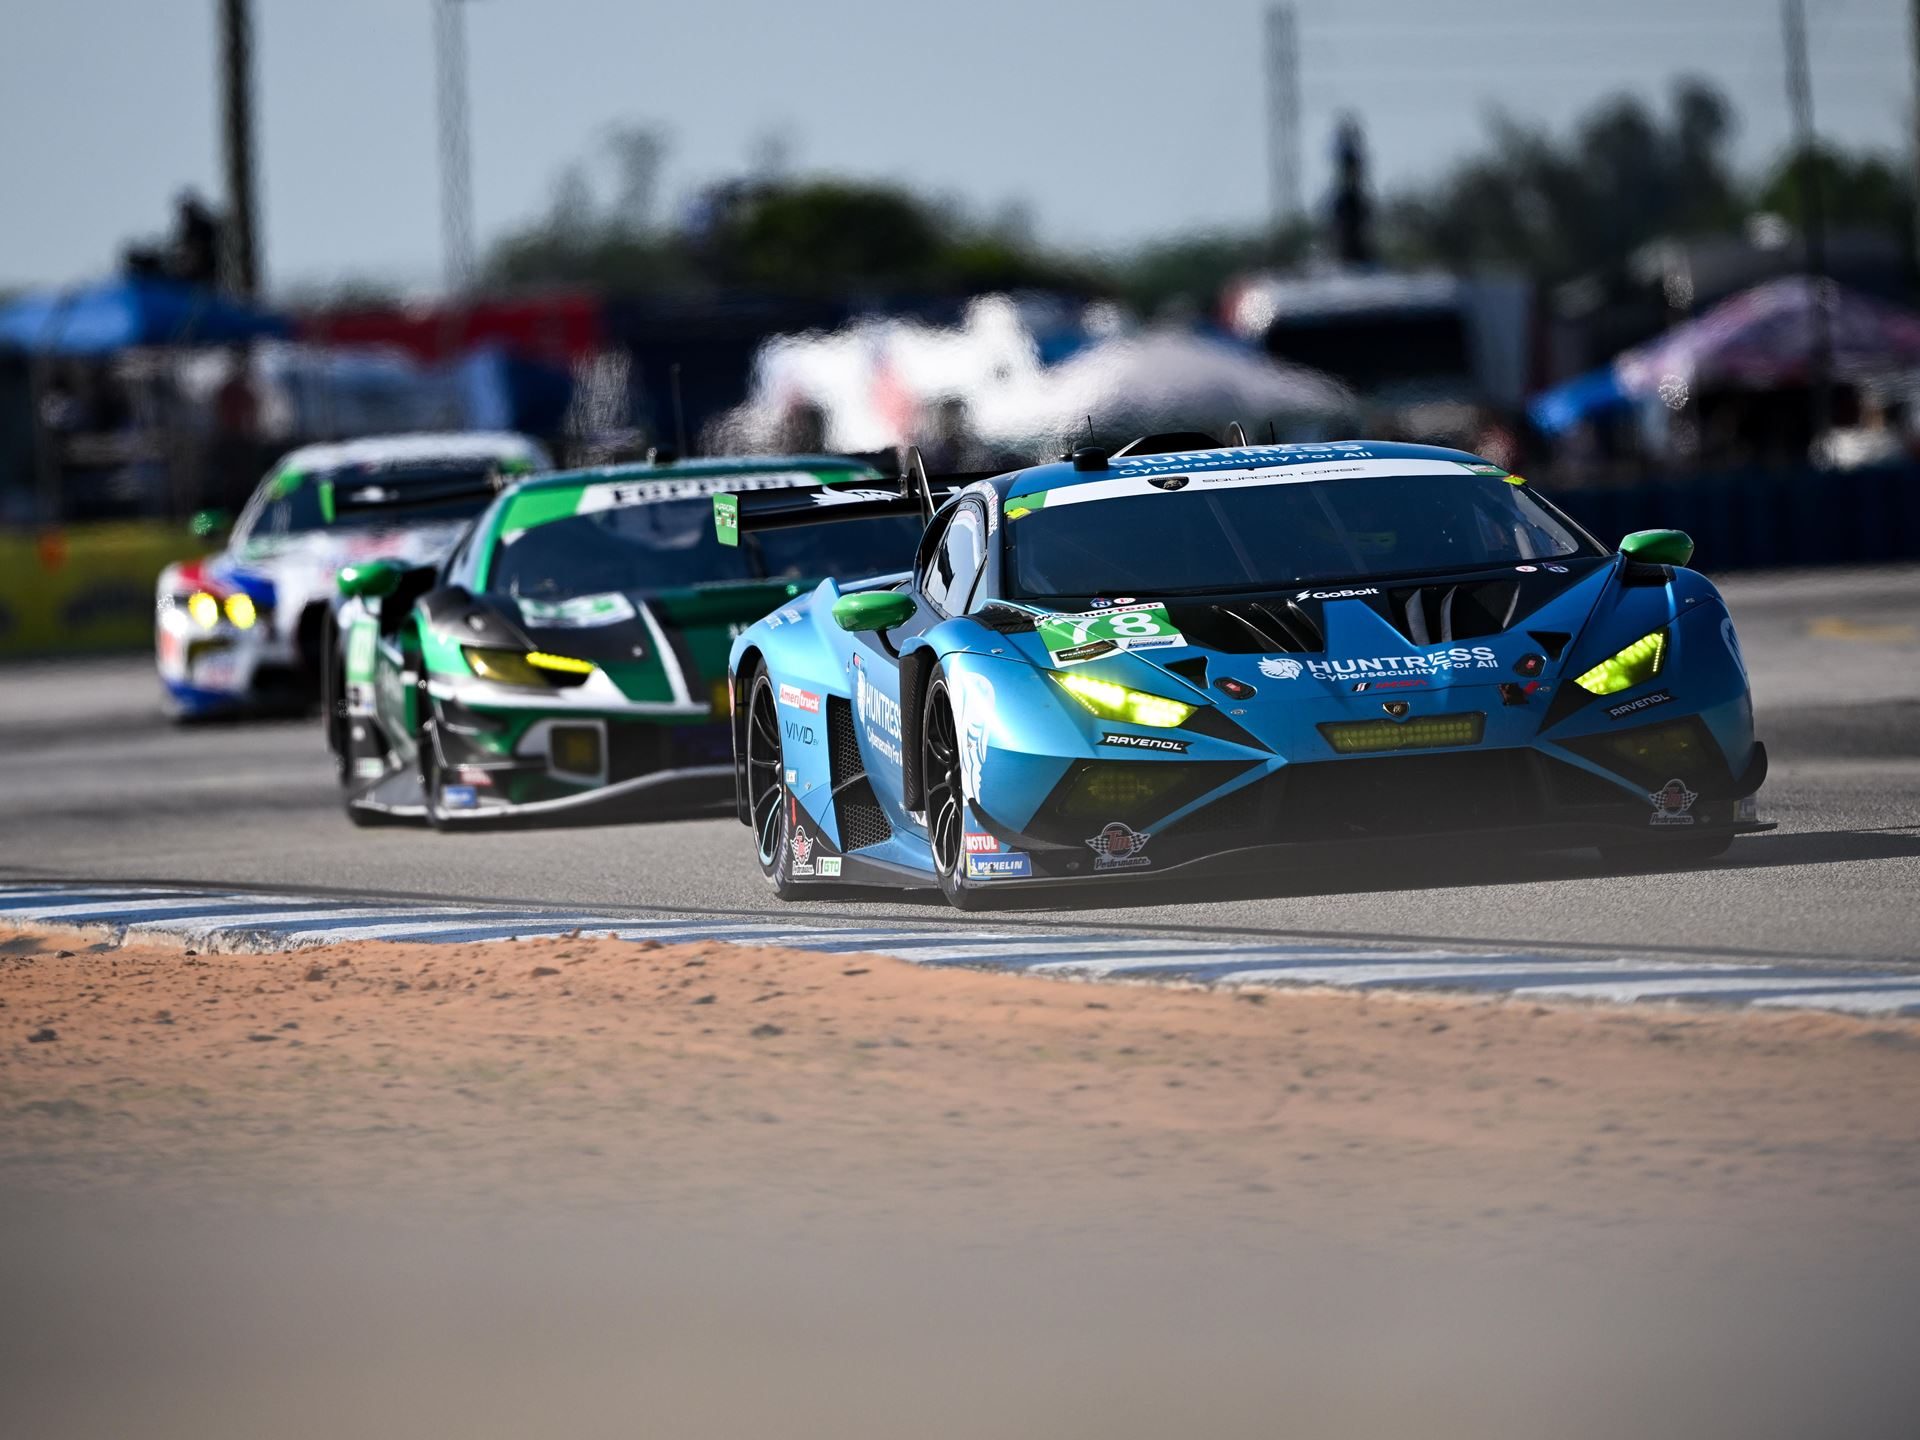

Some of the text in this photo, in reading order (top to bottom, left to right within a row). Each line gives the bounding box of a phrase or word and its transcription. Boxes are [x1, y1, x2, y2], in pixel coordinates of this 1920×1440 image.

[1109, 444, 1365, 467] HUNTRESS
[1118, 450, 1374, 476] Cybersecurity For All
[1202, 466, 1367, 483] SQUADRA CORSE
[1311, 587, 1380, 600] GoBolt
[1036, 603, 1161, 624] WeatherTech
[1051, 613, 1161, 645] 78
[1306, 647, 1495, 673] HUNTRESS
[1312, 659, 1499, 682] Cybersecurity For All
[1610, 693, 1670, 717] RAVENOL
[785, 719, 814, 745] VIVID
[1106, 735, 1184, 751] RAVENOL
[966, 835, 997, 850] MOTUL
[977, 861, 1023, 870] MICHELIN
